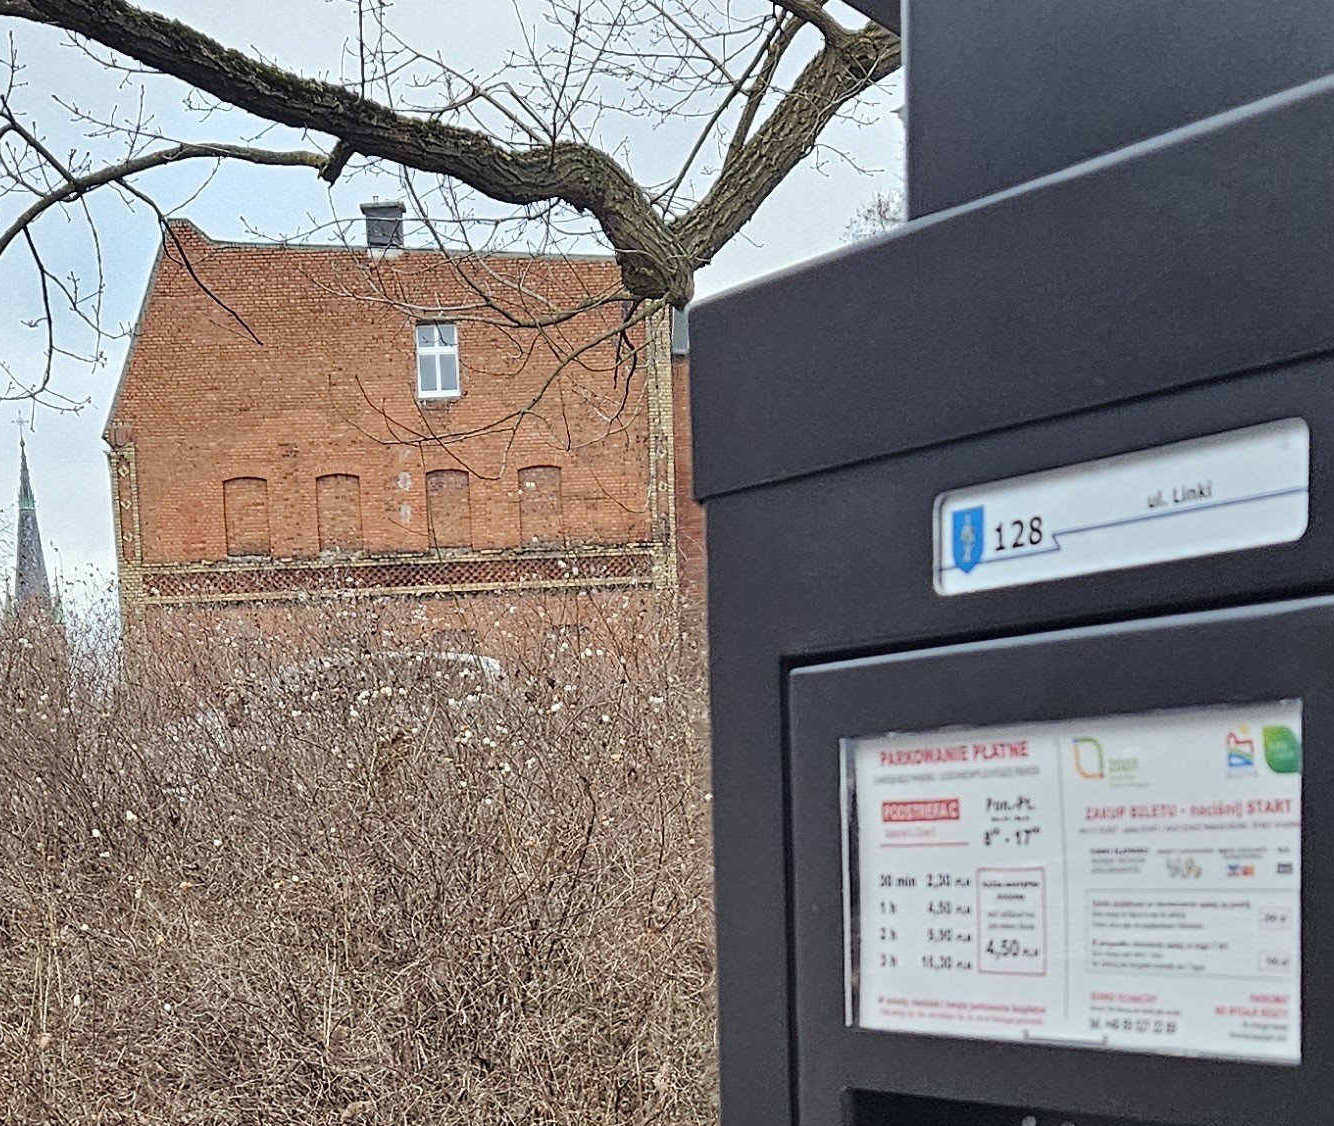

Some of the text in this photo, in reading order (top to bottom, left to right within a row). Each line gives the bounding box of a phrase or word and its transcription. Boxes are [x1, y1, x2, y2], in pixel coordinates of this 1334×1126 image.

[1172, 480, 1213, 504] Linki
[994, 516, 1044, 551] 128
[880, 746, 968, 767] PARKOWANIE
[1130, 803, 1177, 819] BILETU
[1248, 799, 1292, 815] START
[986, 939, 1020, 959] 4,50
